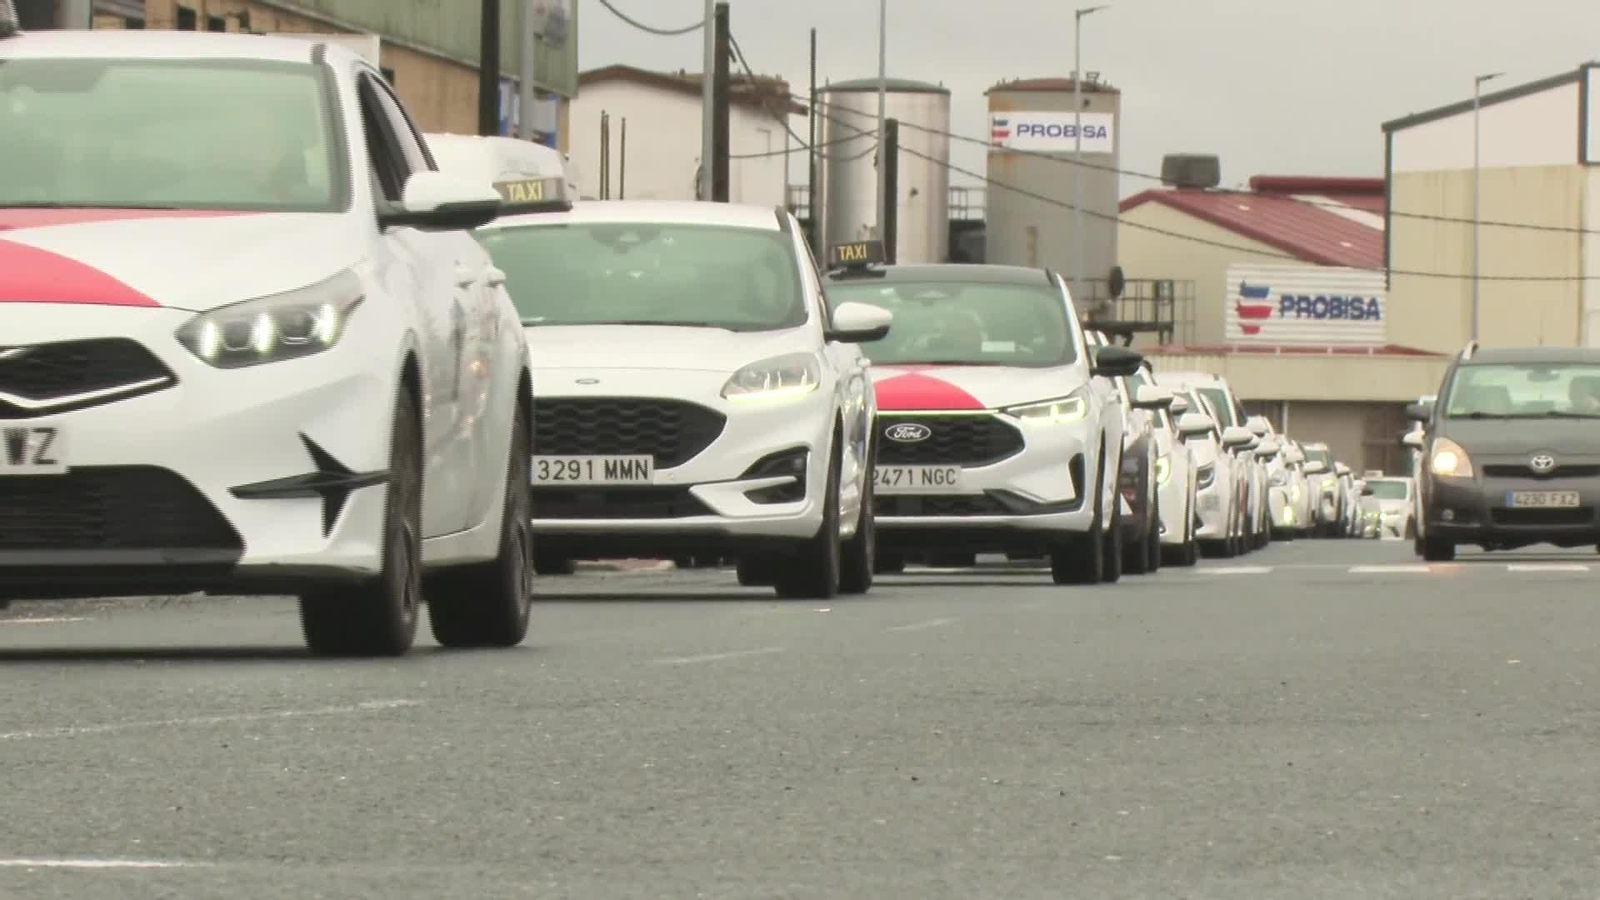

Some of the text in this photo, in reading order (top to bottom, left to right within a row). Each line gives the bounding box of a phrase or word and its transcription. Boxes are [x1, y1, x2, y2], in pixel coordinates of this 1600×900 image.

[1017, 124, 1107, 139] PROBSA
[506, 180, 543, 201] TAXI
[837, 243, 867, 261] TAXI
[1279, 294, 1381, 321] PROBISA
[893, 426, 922, 439] Ford
[537, 459, 648, 481] 3291 MMN
[921, 467, 956, 486] NGC
